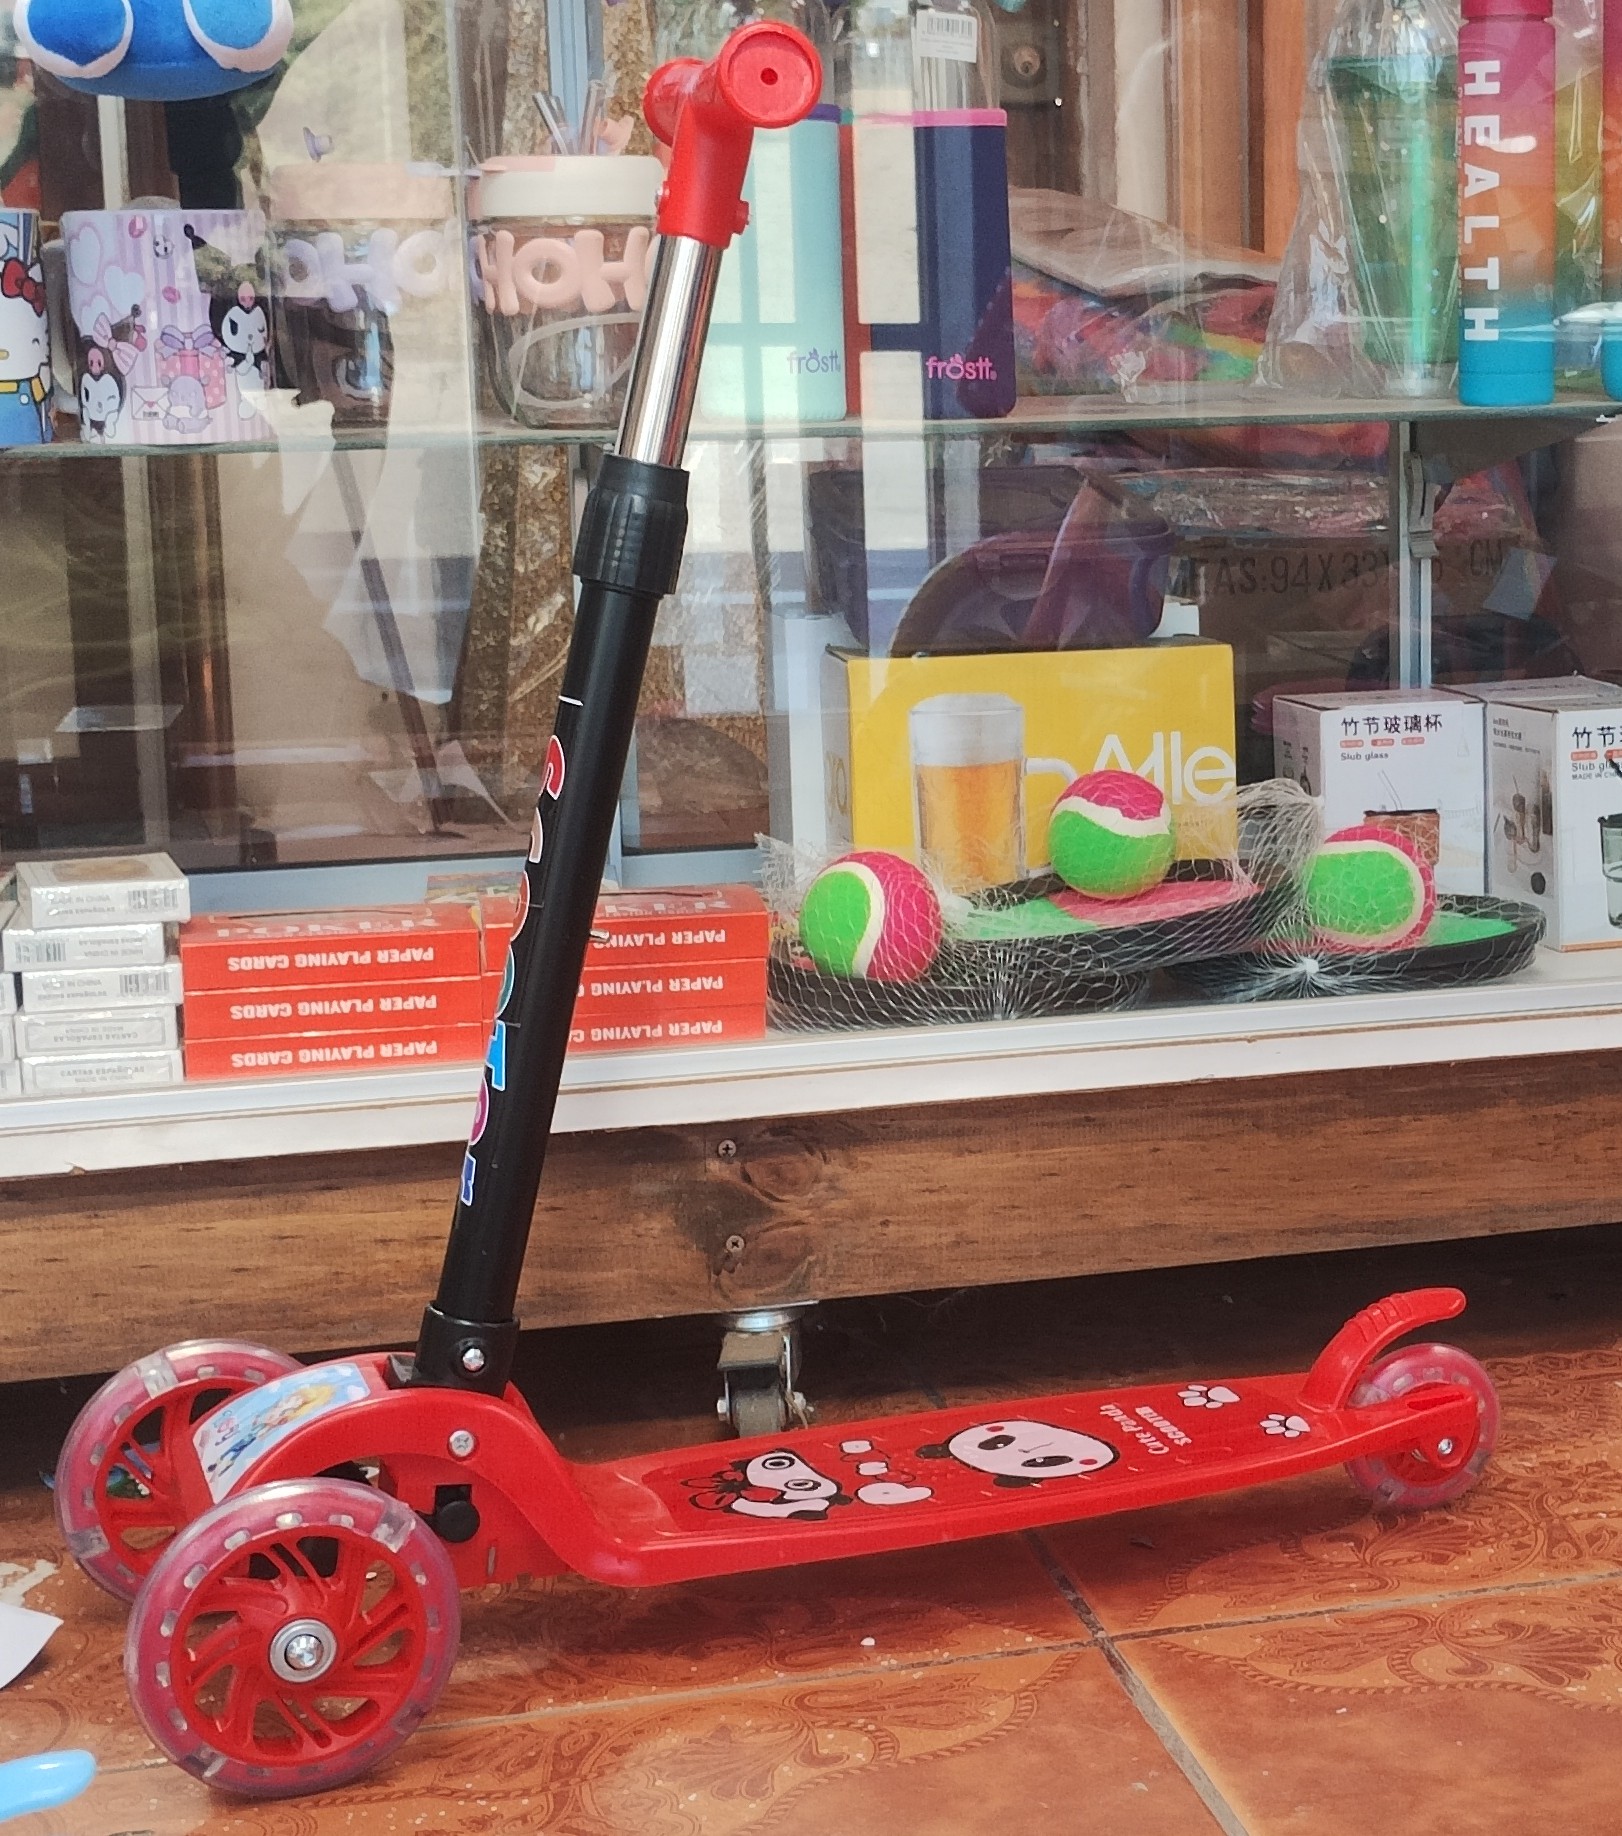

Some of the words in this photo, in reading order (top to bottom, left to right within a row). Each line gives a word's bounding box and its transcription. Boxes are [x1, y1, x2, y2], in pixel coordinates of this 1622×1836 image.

[1464, 60, 1500, 341] HEALTH
[1341, 714, 1442, 736] 竹节玻璃杯
[1572, 726, 1622, 748] 竹节
[671, 928, 726, 945] PAPER
[227, 953, 289, 972] CARDS
[295, 950, 372, 969] PLAYING
[377, 947, 434, 964] PAPER
[590, 979, 663, 997] PLAYING
[669, 975, 724, 992] PAPER
[230, 1002, 292, 1020] CARDS
[297, 998, 374, 1016] PLAYING
[380, 995, 437, 1012] PAPER
[590, 1023, 663, 1042] PLAYING
[668, 1019, 722, 1037] PAPER
[299, 1045, 375, 1064] PLAYING
[380, 1040, 438, 1058] PAPER
[231, 1049, 292, 1068] CARDS
[1135, 1431, 1170, 1455] Cute
